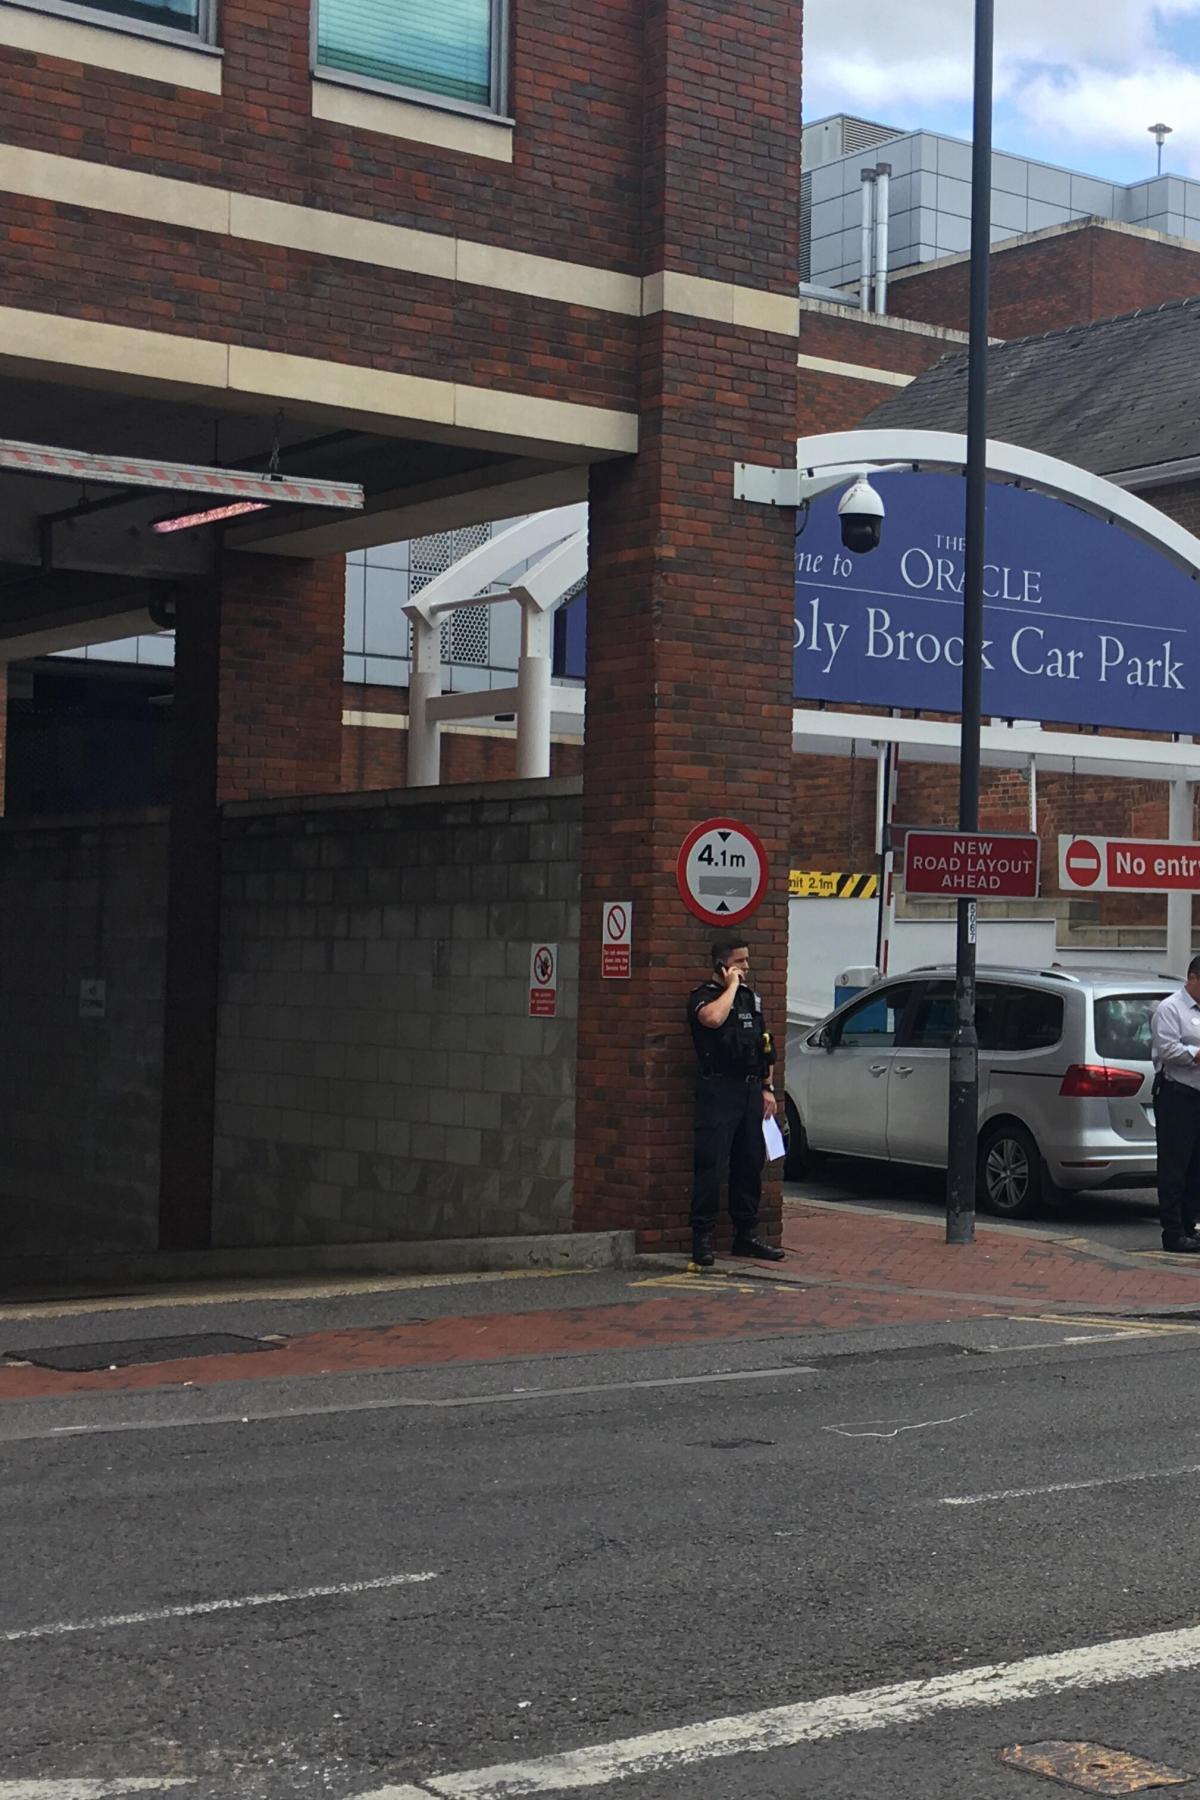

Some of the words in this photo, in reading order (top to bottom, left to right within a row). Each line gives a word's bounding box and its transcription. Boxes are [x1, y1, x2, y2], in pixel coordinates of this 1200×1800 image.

[935, 534, 965, 551] THE
[832, 553, 853, 577] to
[1011, 626, 1084, 680] Car
[1097, 634, 1186, 690] Park
[697, 844, 746, 867] 4.1m
[953, 841, 993, 855] NEW
[913, 856, 961, 871] ROAD
[967, 857, 1032, 873] LAYOUT
[1115, 851, 1146, 876] No
[808, 878, 833, 889] 2.1m
[941, 874, 1001, 889] AHEAD
